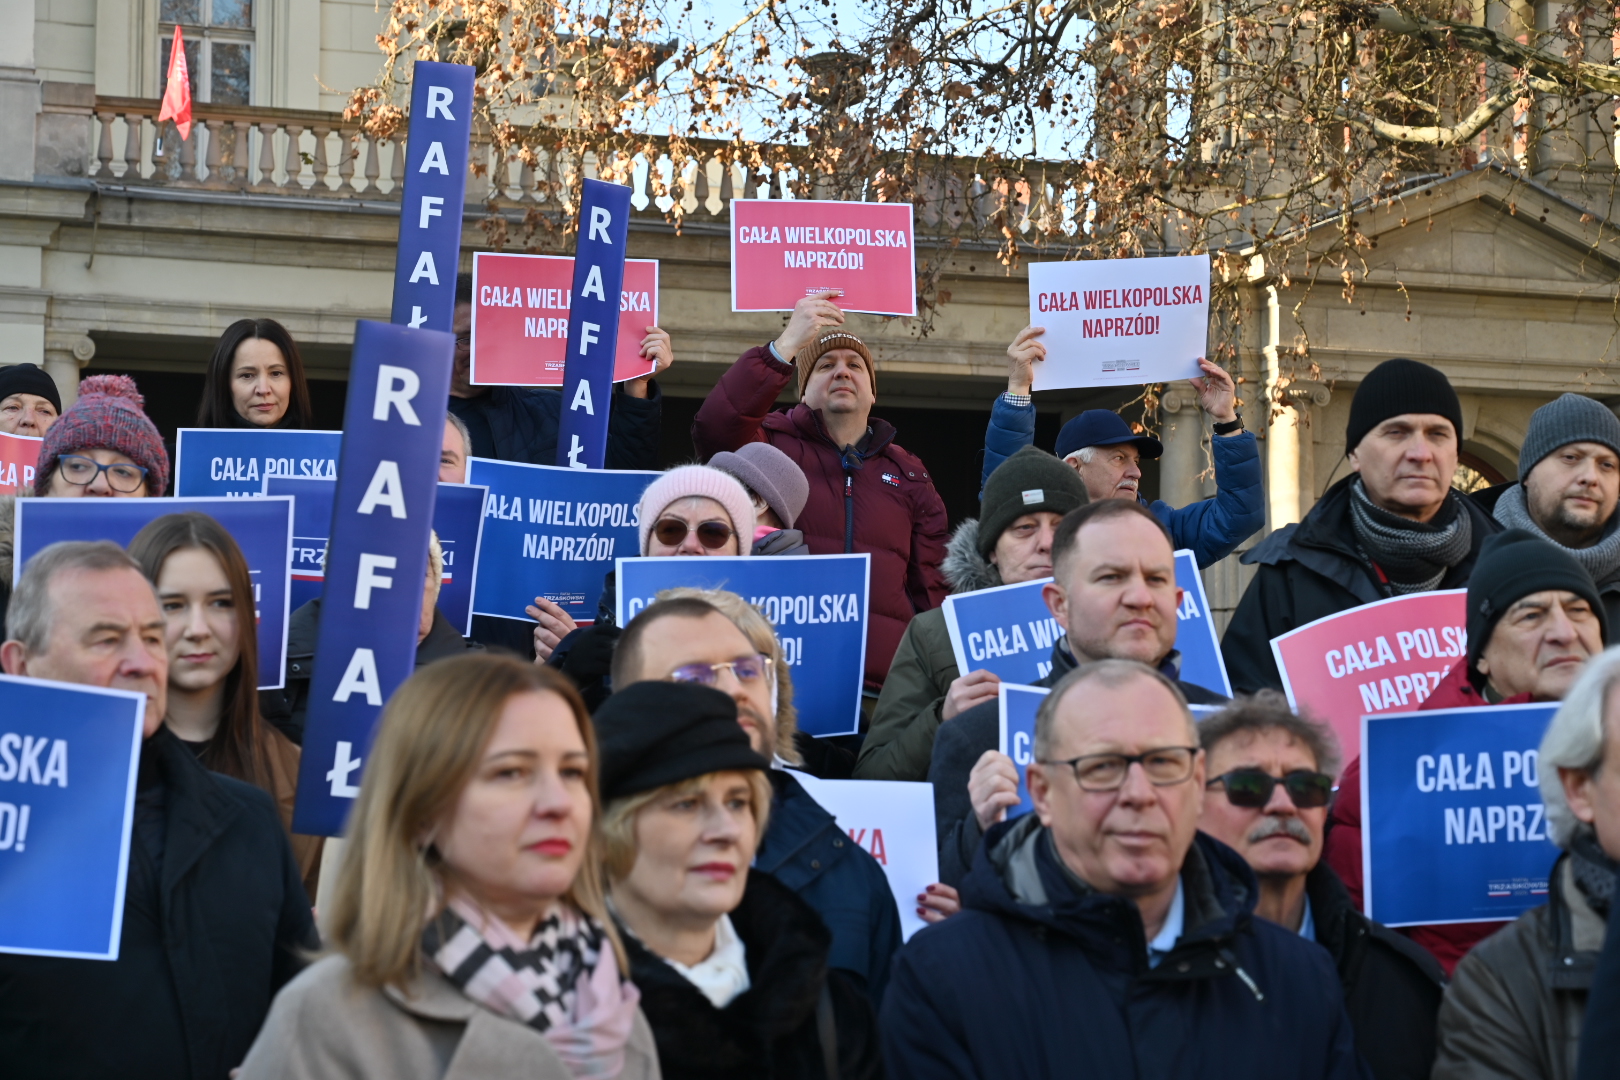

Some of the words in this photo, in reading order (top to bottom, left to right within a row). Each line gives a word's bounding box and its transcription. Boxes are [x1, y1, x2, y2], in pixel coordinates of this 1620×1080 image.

[739, 226, 781, 244] CAŁA
[785, 226, 907, 248] WIELKOPOLSKA
[784, 249, 864, 270] NAPRZÓD!
[480, 285, 523, 308] CAŁA
[526, 287, 651, 312] WIELSKA
[1038, 291, 1080, 313] CAŁA
[1083, 284, 1203, 310] WIELKOPOLSKA
[524, 316, 568, 339] NAPR
[567, 205, 613, 470] RAFAŁ
[1082, 313, 1161, 339] NAPRZÓD!
[210, 457, 260, 481] CAŁA
[484, 493, 523, 522] AŁA
[529, 498, 641, 528] WIELKOPOLS
[522, 532, 615, 562] NAPRZÓD!
[325, 363, 422, 800] RAFAŁ
[967, 624, 1029, 662] CAŁA
[1325, 635, 1398, 679] CAŁA
[1395, 626, 1468, 661] POLSK
[1415, 752, 1496, 793] CAŁA
[1444, 803, 1553, 845] NAPRZ
